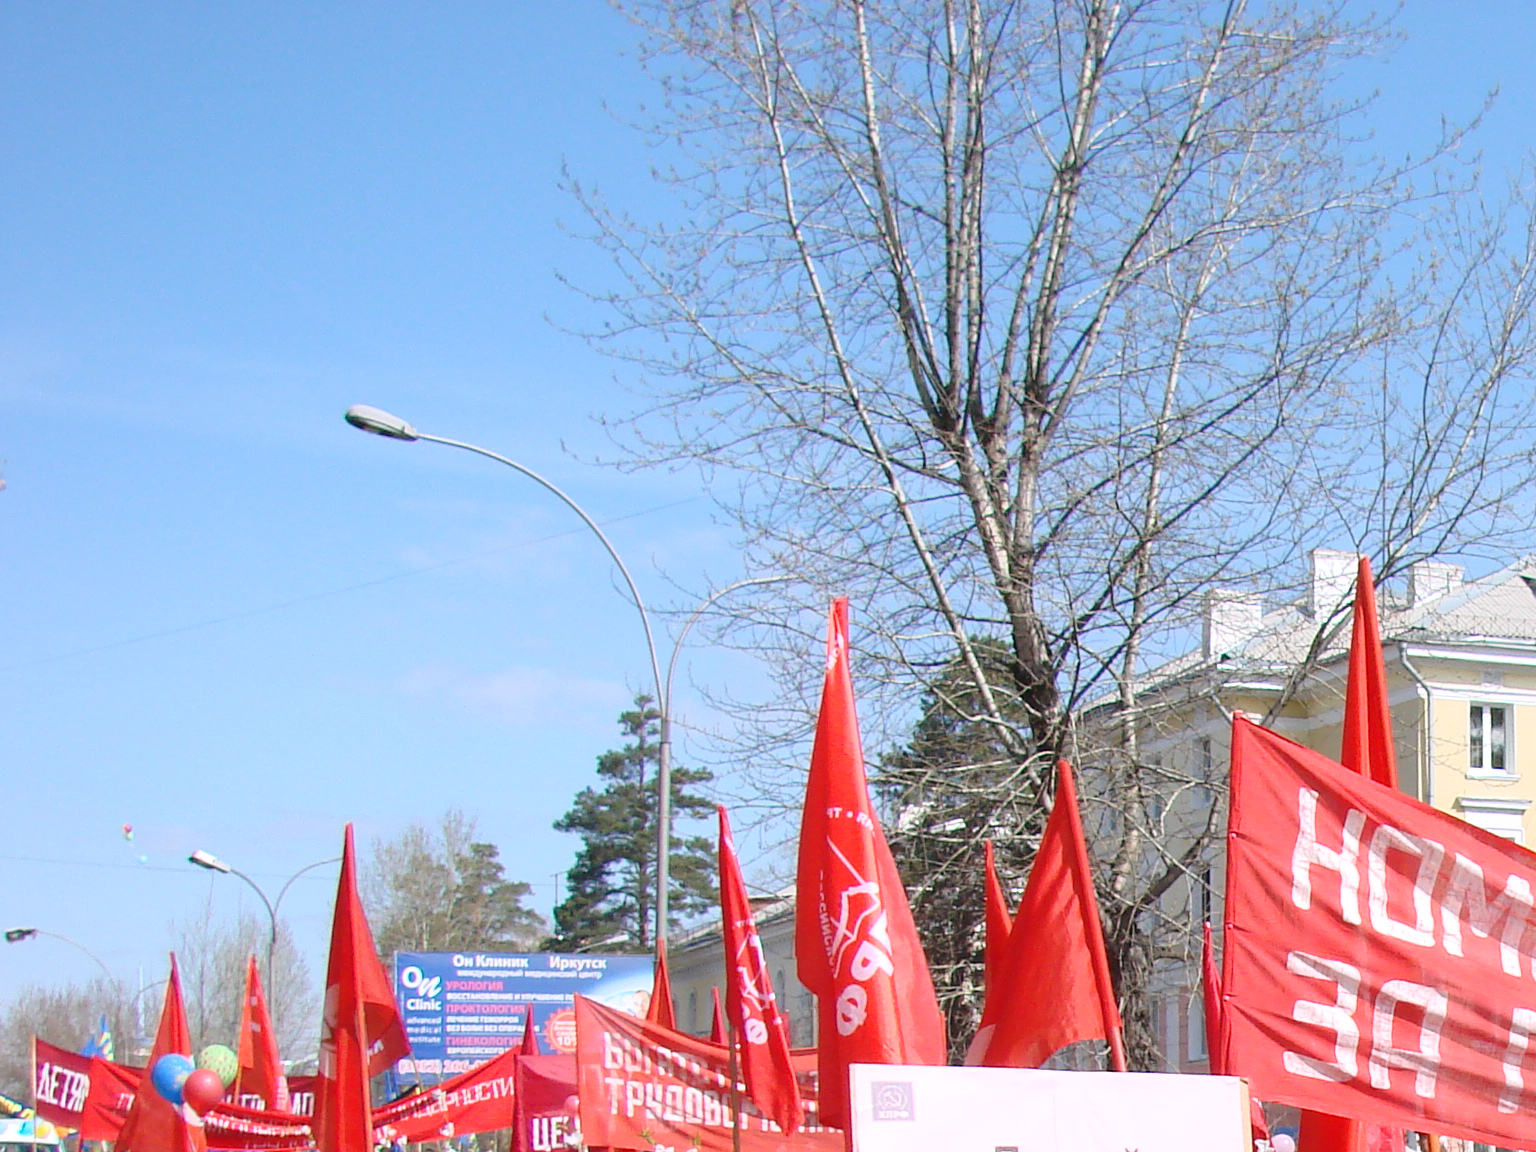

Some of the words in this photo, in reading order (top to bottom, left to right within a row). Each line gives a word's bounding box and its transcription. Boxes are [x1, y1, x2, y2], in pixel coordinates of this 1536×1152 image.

[453, 955, 474, 967] Он
[475, 955, 529, 968] Клиник
[549, 955, 607, 971] Иркутск
[446, 980, 504, 991] УРОЛОГИЯ
[406, 998, 442, 1011] Clinic
[446, 1003, 526, 1014] ПРОКТОЛОГИЯ
[1283, 950, 1448, 1099] ЗА
